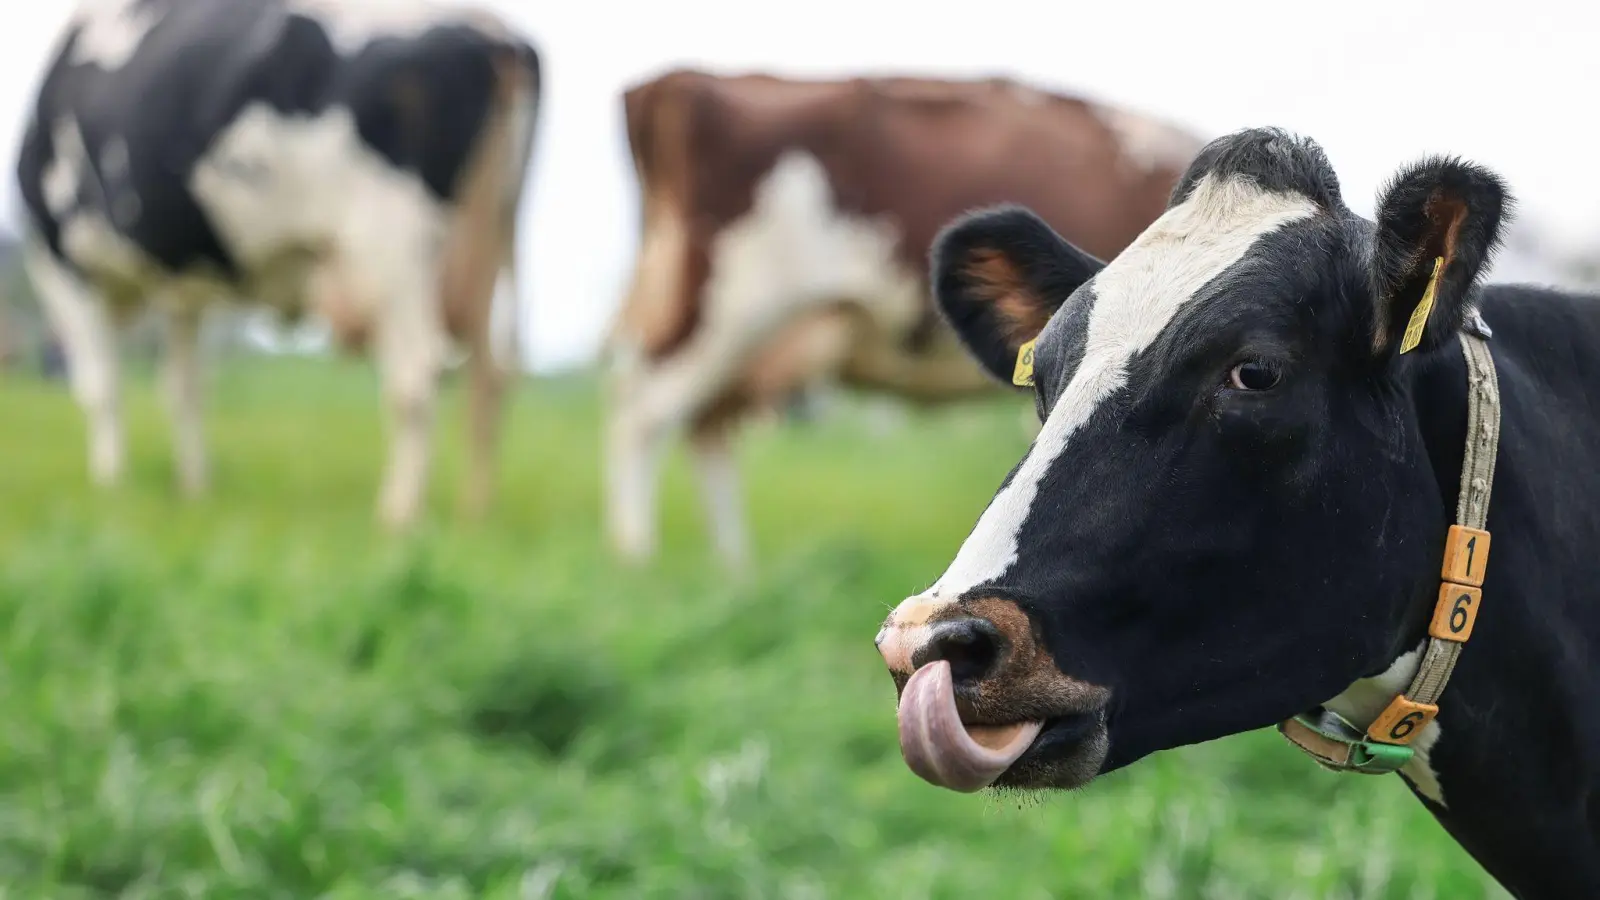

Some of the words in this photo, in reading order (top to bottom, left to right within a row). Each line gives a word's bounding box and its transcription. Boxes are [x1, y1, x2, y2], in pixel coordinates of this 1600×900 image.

[1466, 536, 1476, 577] 1
[1449, 593, 1472, 633] 6
[1390, 711, 1424, 739] 6
